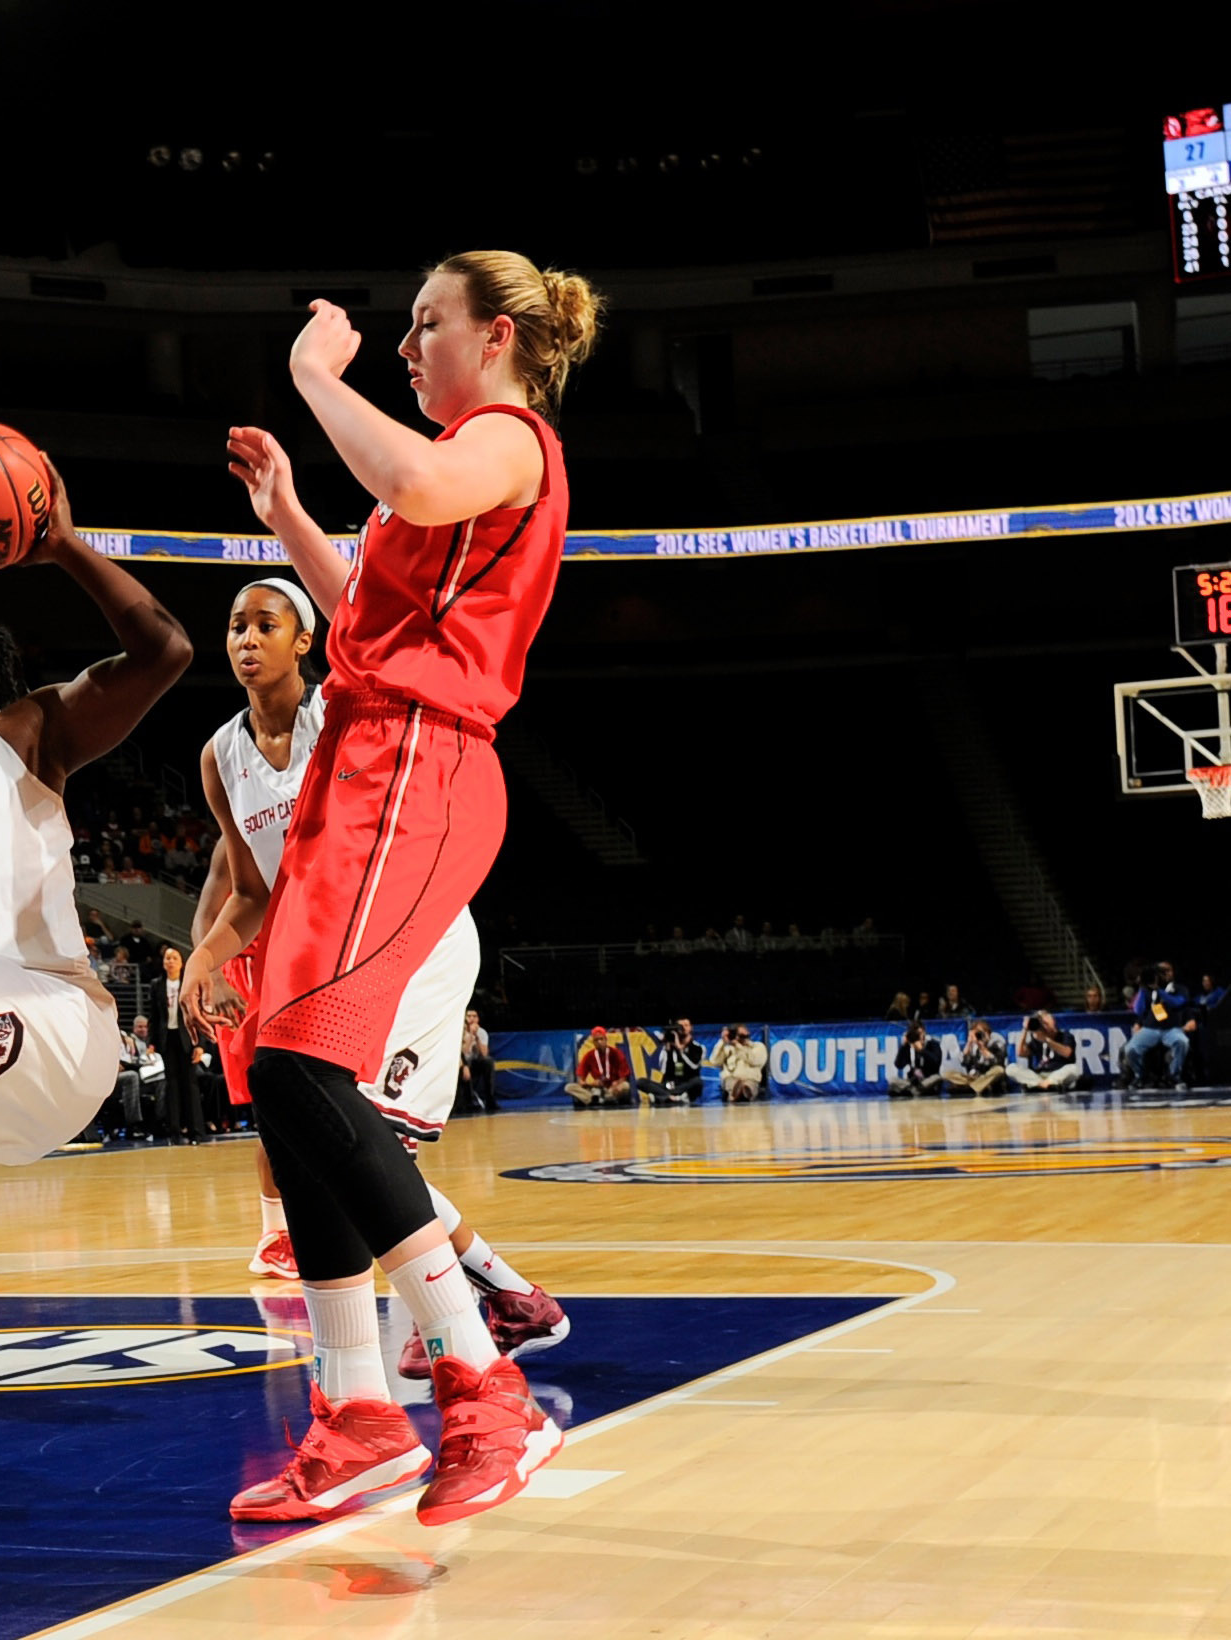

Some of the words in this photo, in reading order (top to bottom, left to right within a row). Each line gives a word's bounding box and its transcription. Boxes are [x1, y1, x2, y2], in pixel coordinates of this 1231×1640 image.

[1184, 140, 1206, 162] 27
[1114, 504, 1159, 529] 2014
[1160, 501, 1193, 526] SEC
[655, 533, 696, 555] 2014
[697, 532, 729, 554] SEC
[729, 526, 806, 553] WOMEN'S
[809, 519, 906, 548] BASKETBALL
[904, 512, 1010, 542] TOURNAMENT
[222, 538, 261, 562] 2014
[1197, 570, 1231, 597] 5:2
[243, 806, 276, 835] SOUTH
[277, 798, 297, 820] CAR
